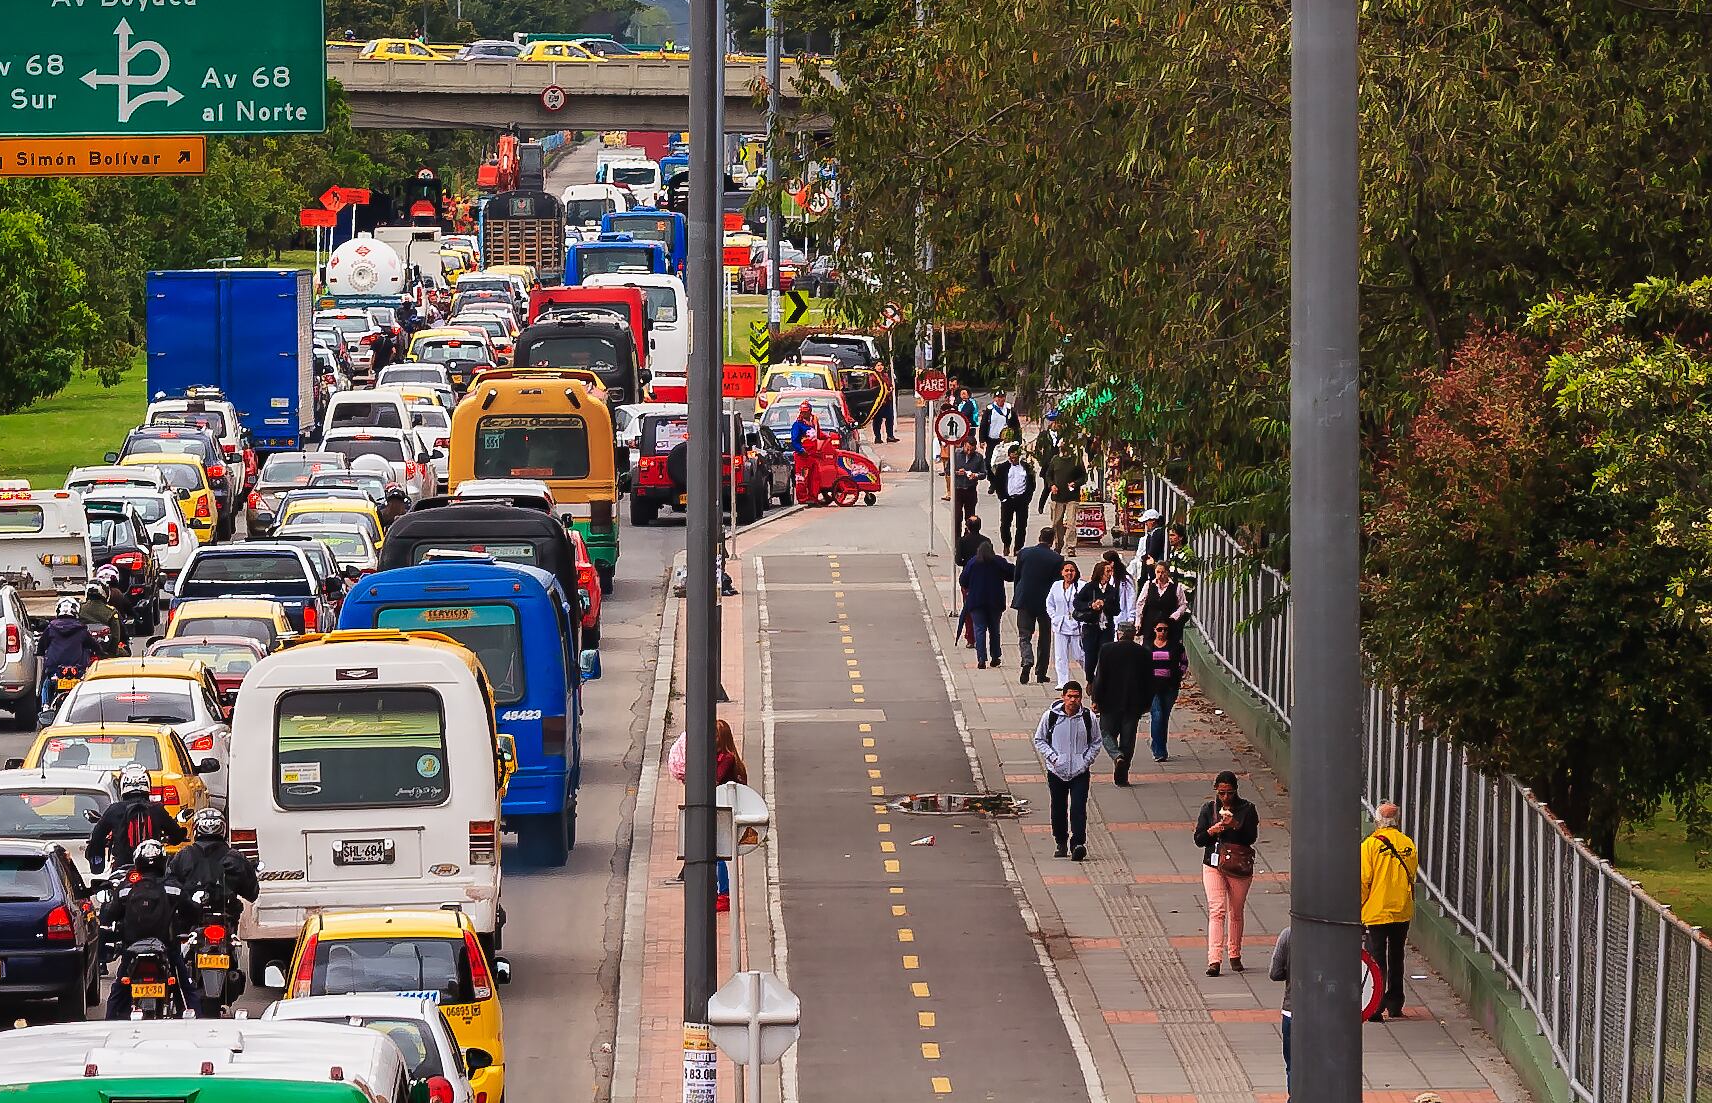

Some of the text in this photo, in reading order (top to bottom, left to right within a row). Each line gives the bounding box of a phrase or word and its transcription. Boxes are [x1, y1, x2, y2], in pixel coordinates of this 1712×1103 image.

[25, 54, 65, 76] 68
[201, 66, 291, 89] Av 68
[10, 88, 57, 110] Sur
[202, 100, 308, 122] al Norte
[16, 152, 76, 166] Simón
[89, 151, 161, 166] Bolívar
[727, 371, 752, 379] LA VIA
[919, 378, 944, 391] PARE
